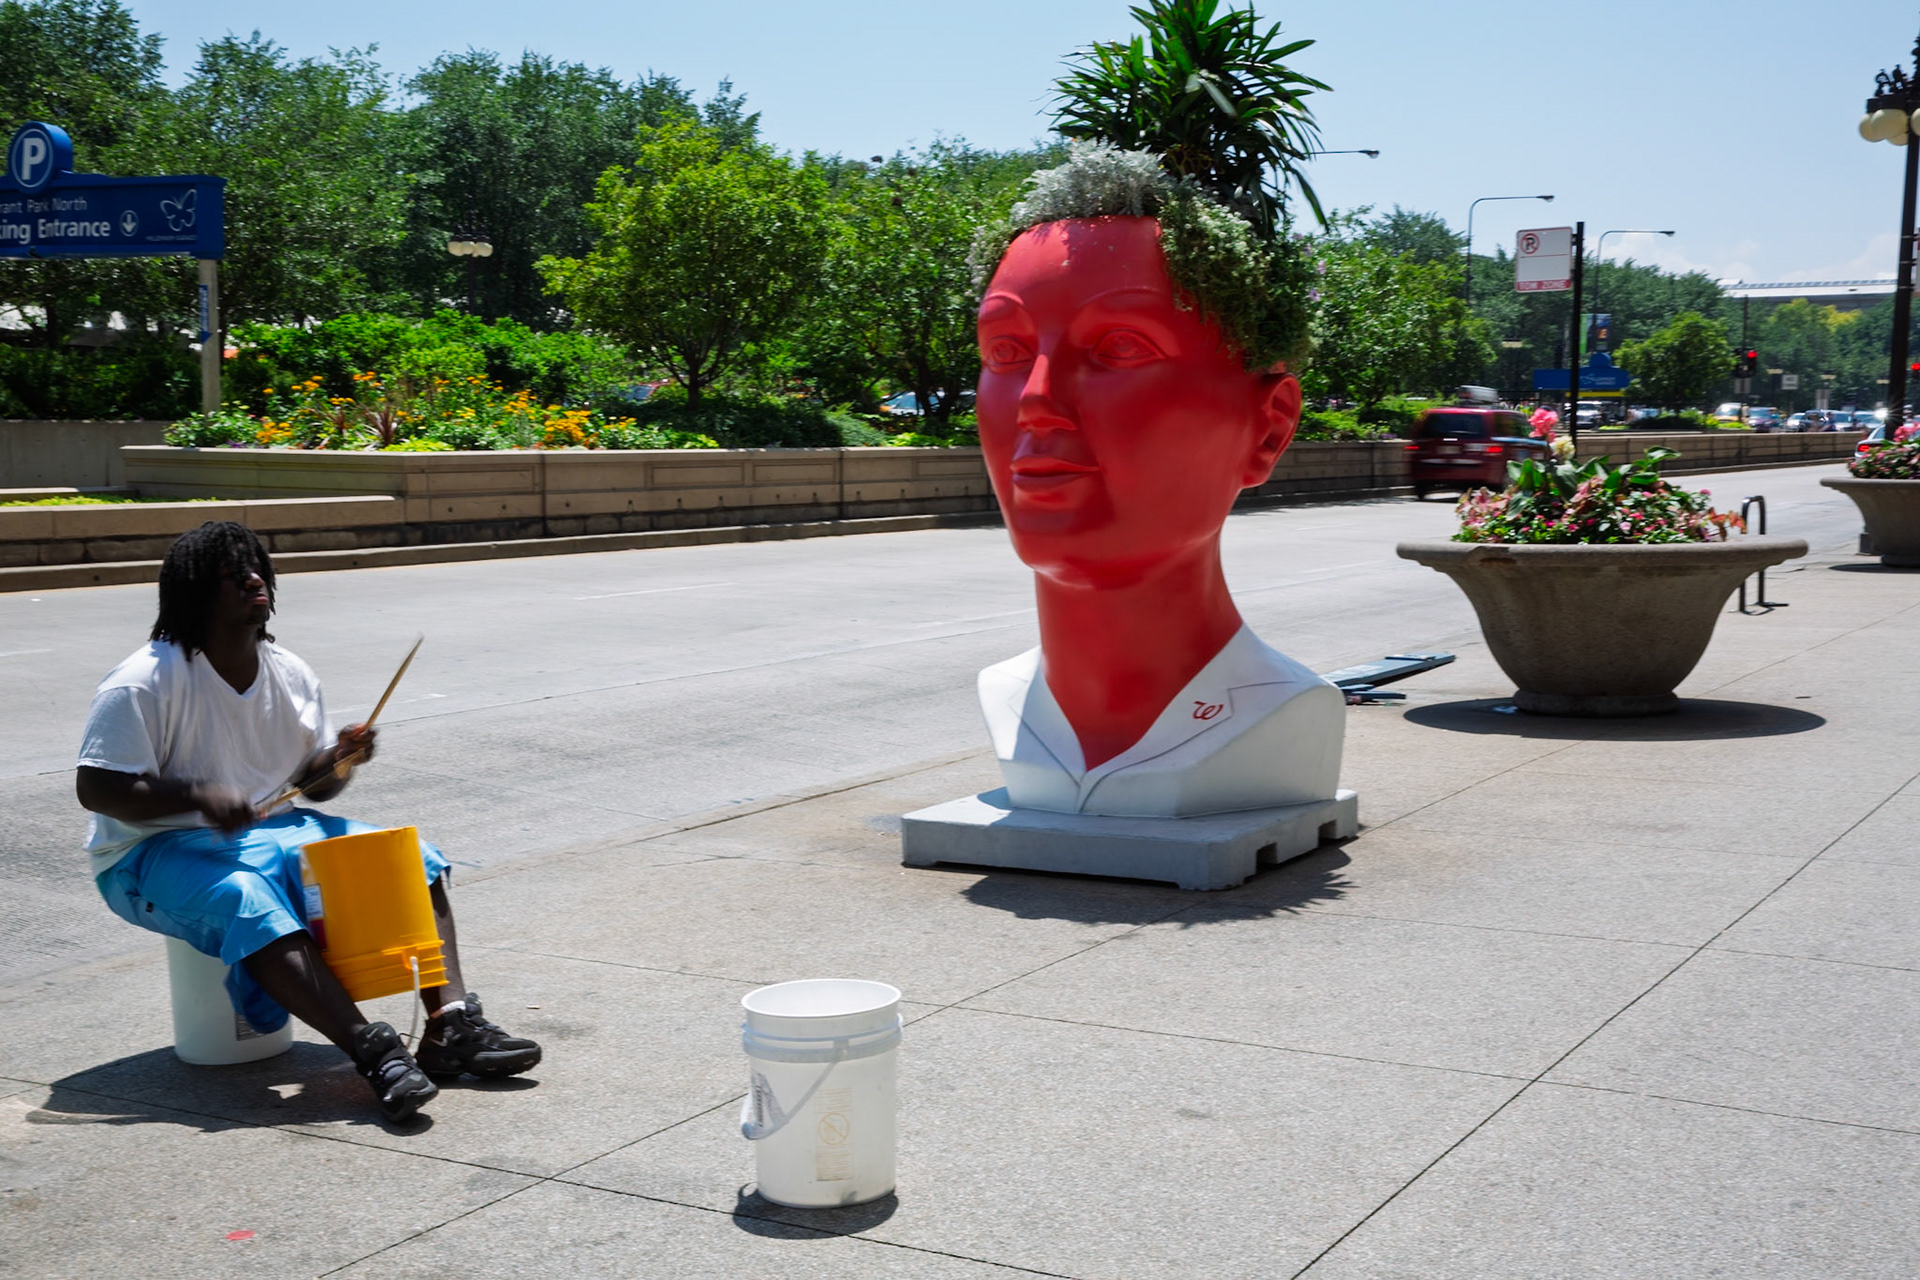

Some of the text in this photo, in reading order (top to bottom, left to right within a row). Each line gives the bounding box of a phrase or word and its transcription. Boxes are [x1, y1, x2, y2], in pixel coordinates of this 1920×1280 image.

[22, 137, 47, 180] P
[52, 196, 87, 211] North
[38, 219, 111, 238] Entrance
